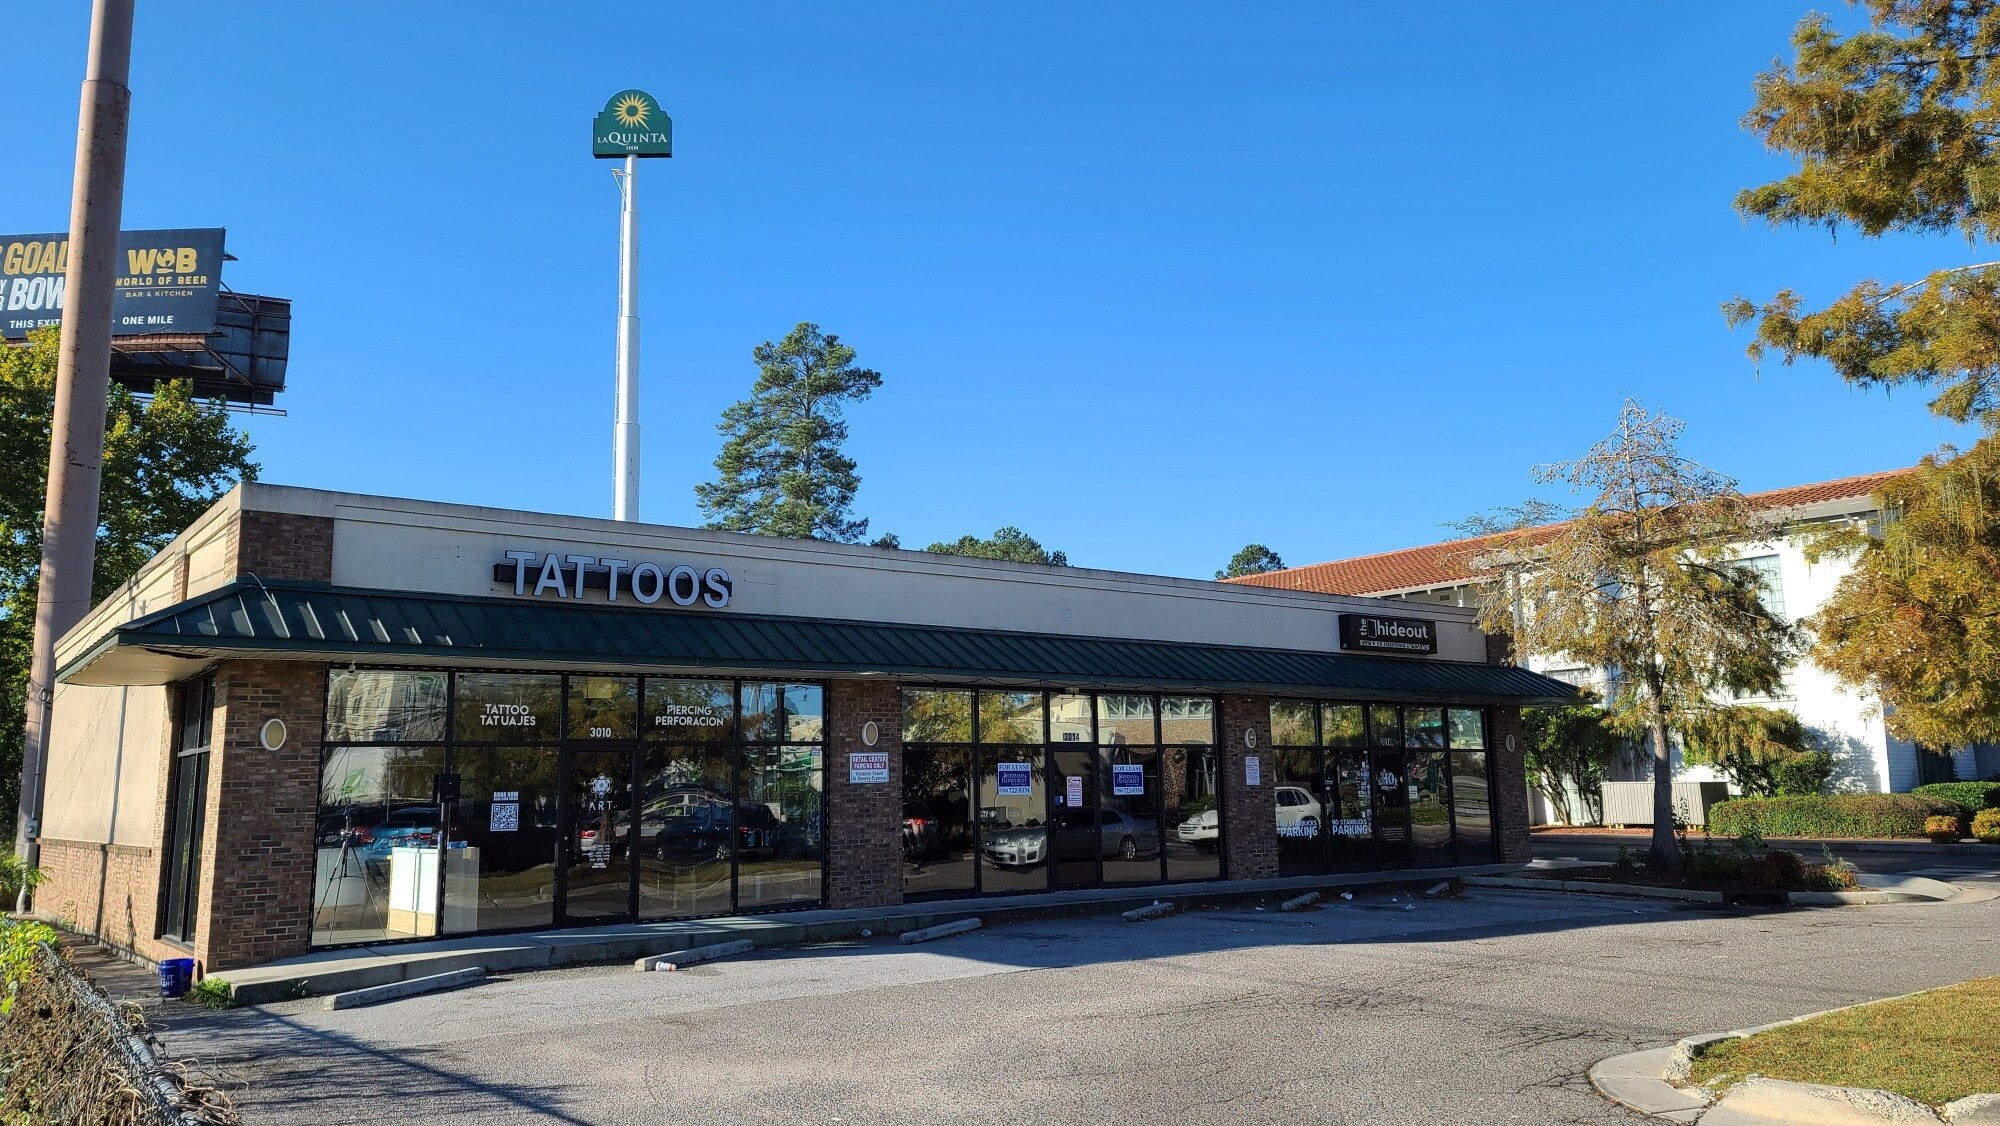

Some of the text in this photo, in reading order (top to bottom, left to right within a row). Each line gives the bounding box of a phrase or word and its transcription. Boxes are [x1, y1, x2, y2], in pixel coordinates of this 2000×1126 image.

[158, 276, 173, 285] OF
[177, 275, 208, 285] BEER
[7, 276, 66, 311] BOW
[9, 318, 61, 329] THIS EXIT
[122, 315, 174, 325] ONE MILE
[504, 550, 730, 609] TATTOOS
[1376, 619, 1428, 639] hideout
[484, 703, 530, 715] TATTOO
[666, 704, 713, 716] PIERCING
[479, 714, 536, 726] TATUAJES
[655, 715, 724, 727] PERFORACION
[589, 727, 612, 738] 3010
[1063, 732, 1080, 741] 3014
[588, 800, 613, 811] ART
[1288, 819, 1318, 827] STARBUCKS
[1280, 826, 1318, 837] PARKING
[1332, 824, 1368, 835] PARKING
